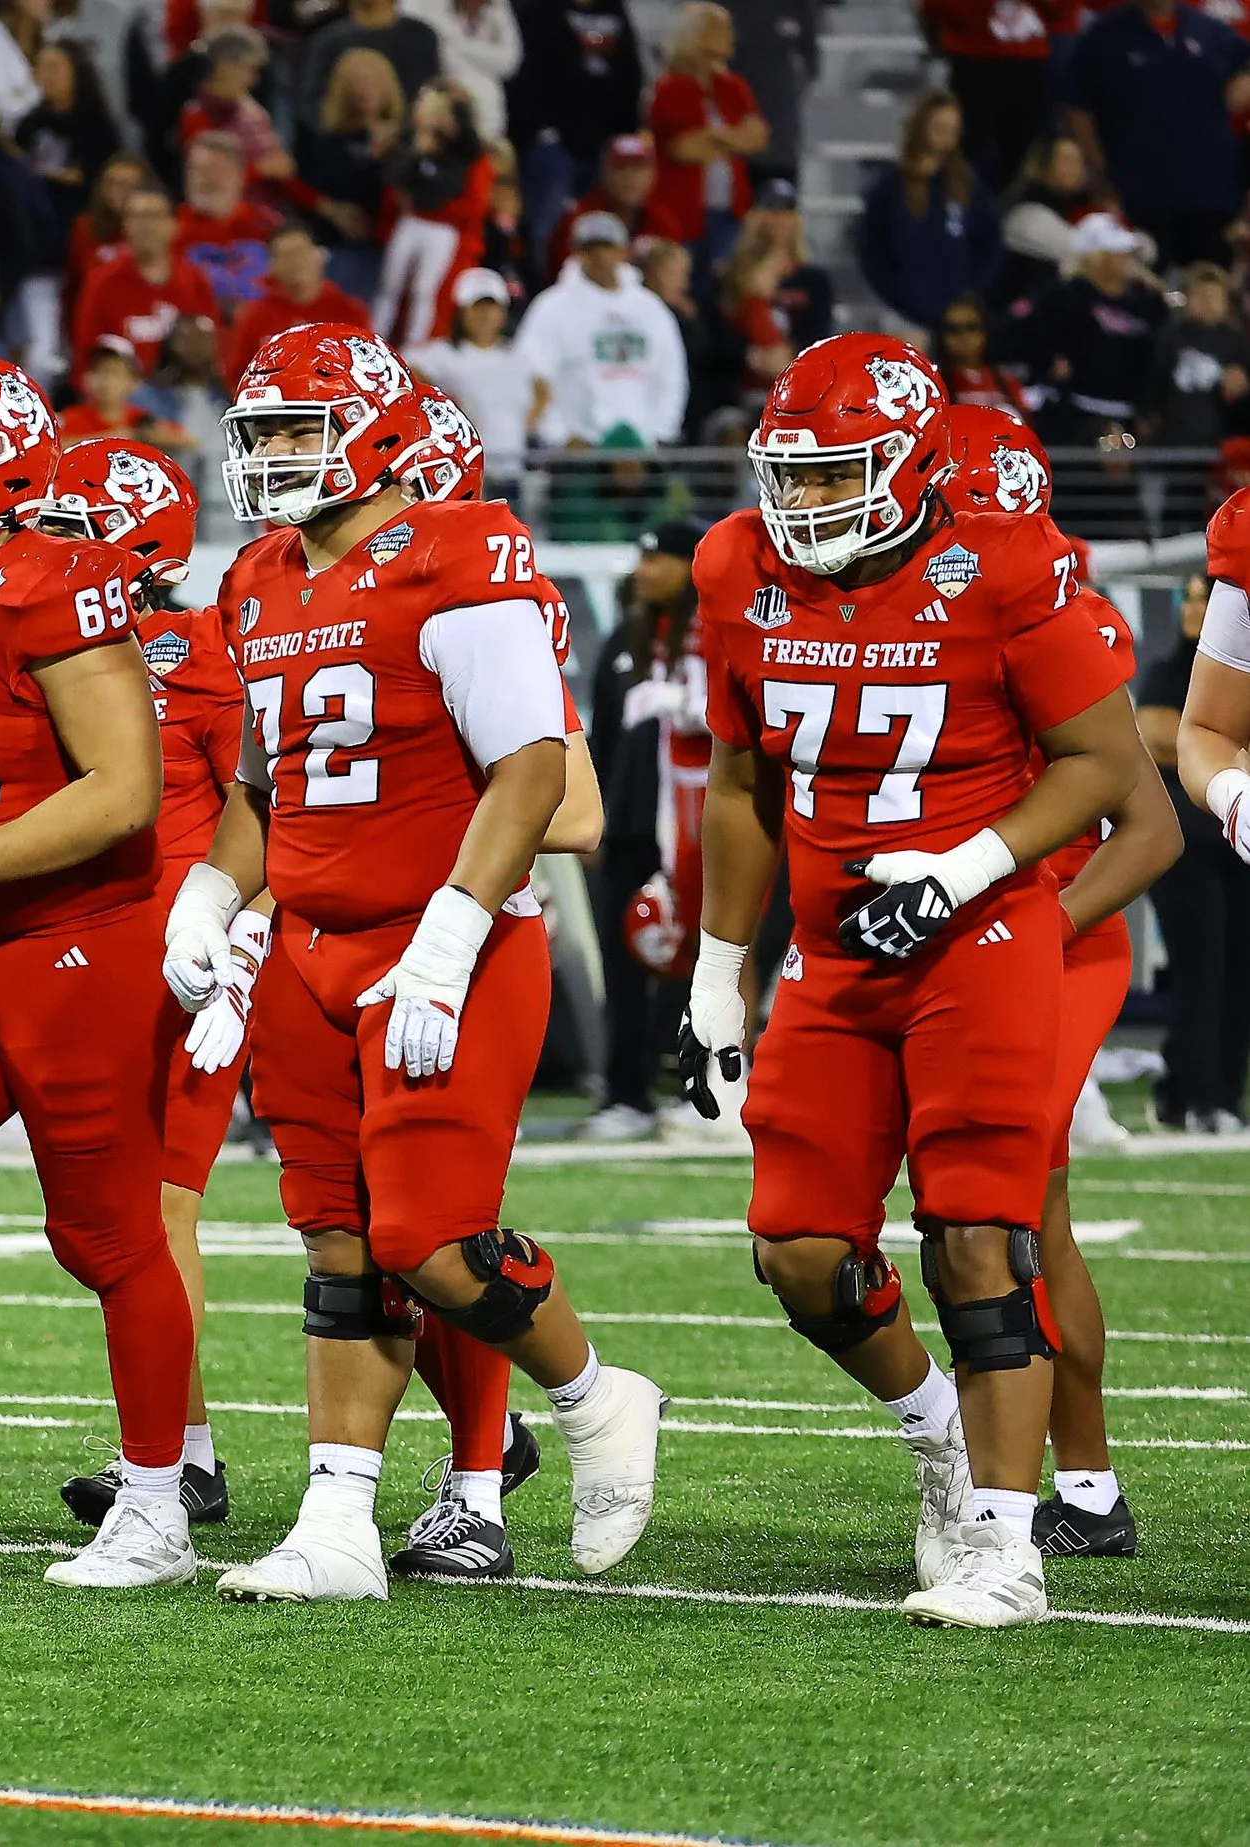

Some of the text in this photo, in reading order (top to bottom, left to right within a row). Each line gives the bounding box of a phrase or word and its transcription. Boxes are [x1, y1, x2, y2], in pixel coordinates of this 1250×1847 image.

[486, 533, 534, 584] 72
[929, 561, 975, 576] ARIZONA
[937, 571, 968, 582] BOWL
[73, 577, 128, 640] 69
[144, 646, 186, 656] ARIZONA
[149, 653, 178, 661] BOWL
[242, 620, 367, 667] FRESNO STATE
[762, 637, 941, 668] FRESNO STATE
[246, 662, 380, 808] 72
[762, 679, 950, 825] 77
